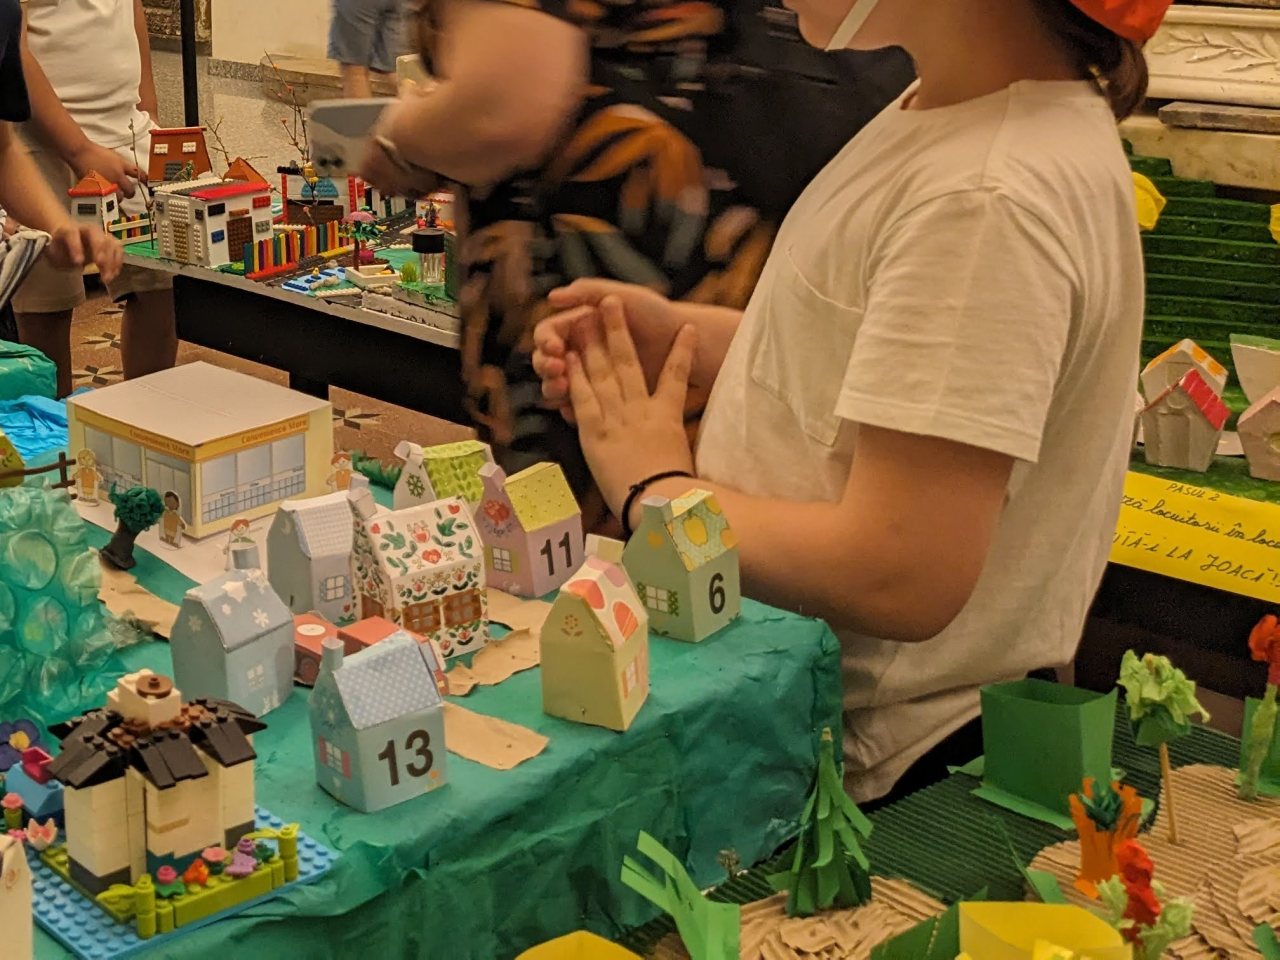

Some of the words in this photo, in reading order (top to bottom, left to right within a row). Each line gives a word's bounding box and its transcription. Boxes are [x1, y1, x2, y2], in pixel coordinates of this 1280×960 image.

[288, 418, 307, 431] Store
[1166, 483, 1205, 498] PASUL
[1208, 493, 1220, 502] 2
[1224, 522, 1245, 540] în
[540, 531, 574, 576] 11
[1166, 546, 1193, 561] LA
[708, 572, 725, 615] 6
[378, 729, 433, 787] 13
